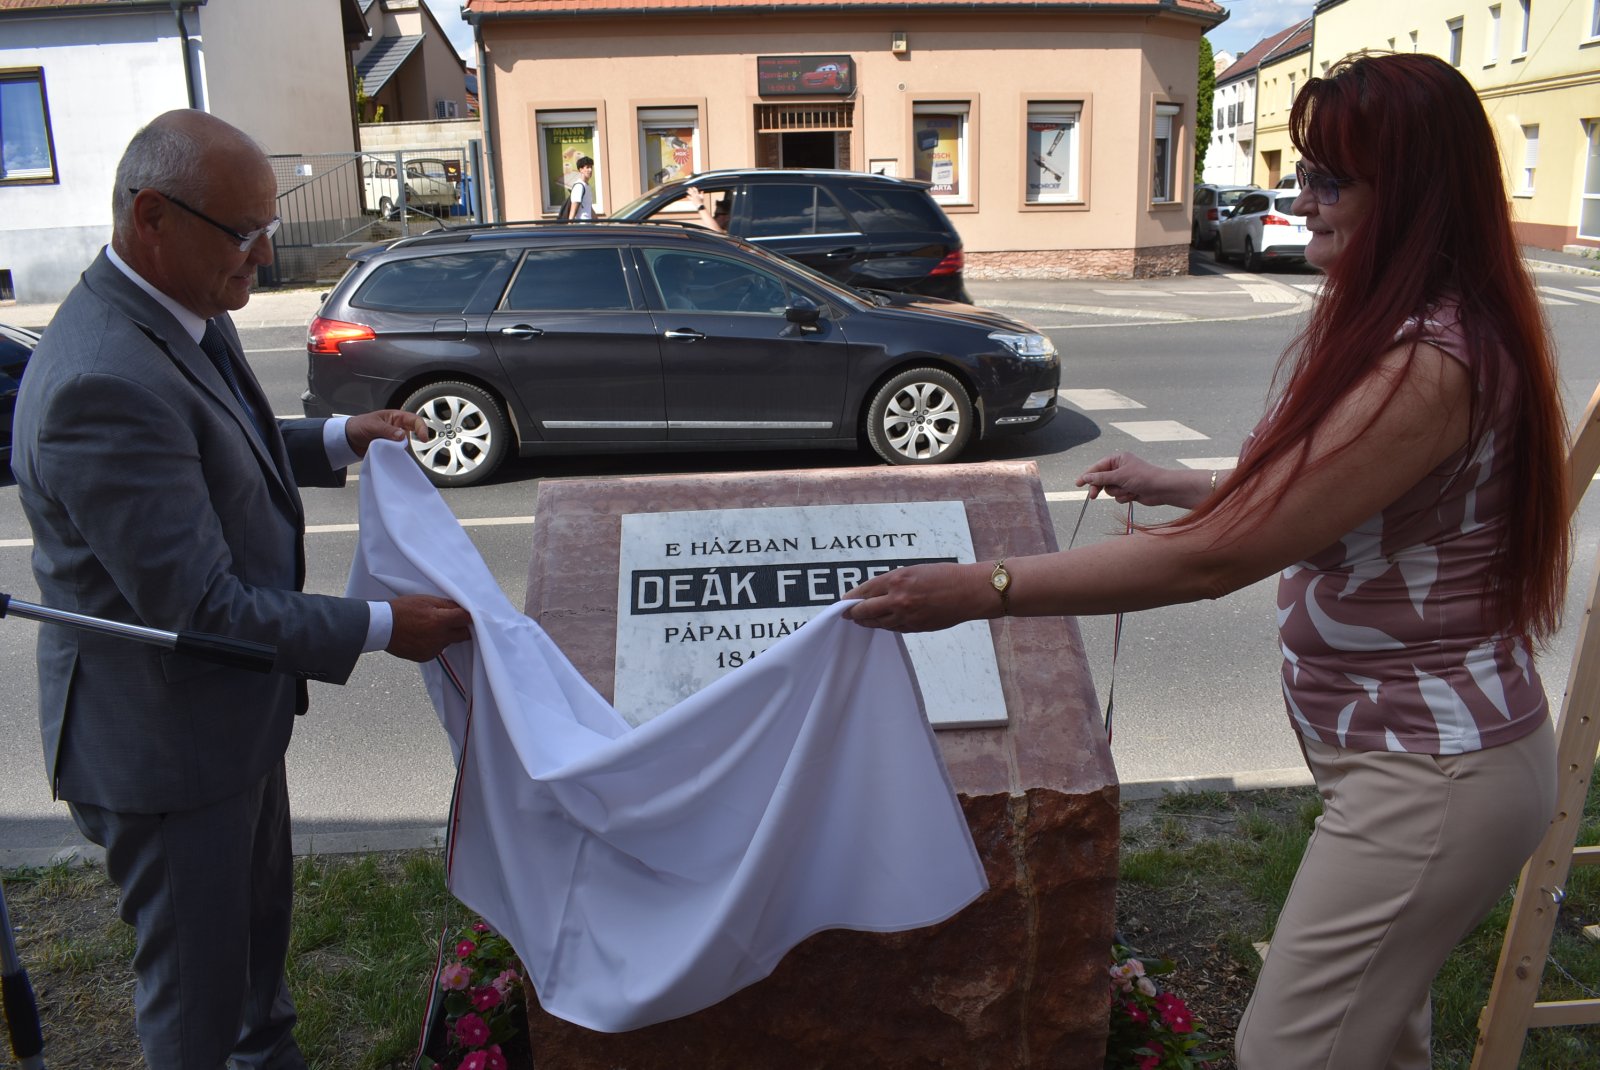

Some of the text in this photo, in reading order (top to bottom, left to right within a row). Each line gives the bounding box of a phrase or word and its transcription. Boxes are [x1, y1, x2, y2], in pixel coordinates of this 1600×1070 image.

[553, 128, 584, 136] MANN
[553, 136, 586, 144] FILTER
[665, 533, 918, 557] E HÁZBAN LAKOTT
[638, 568, 757, 609] DEÁK
[665, 622, 741, 643] PÁPAI
